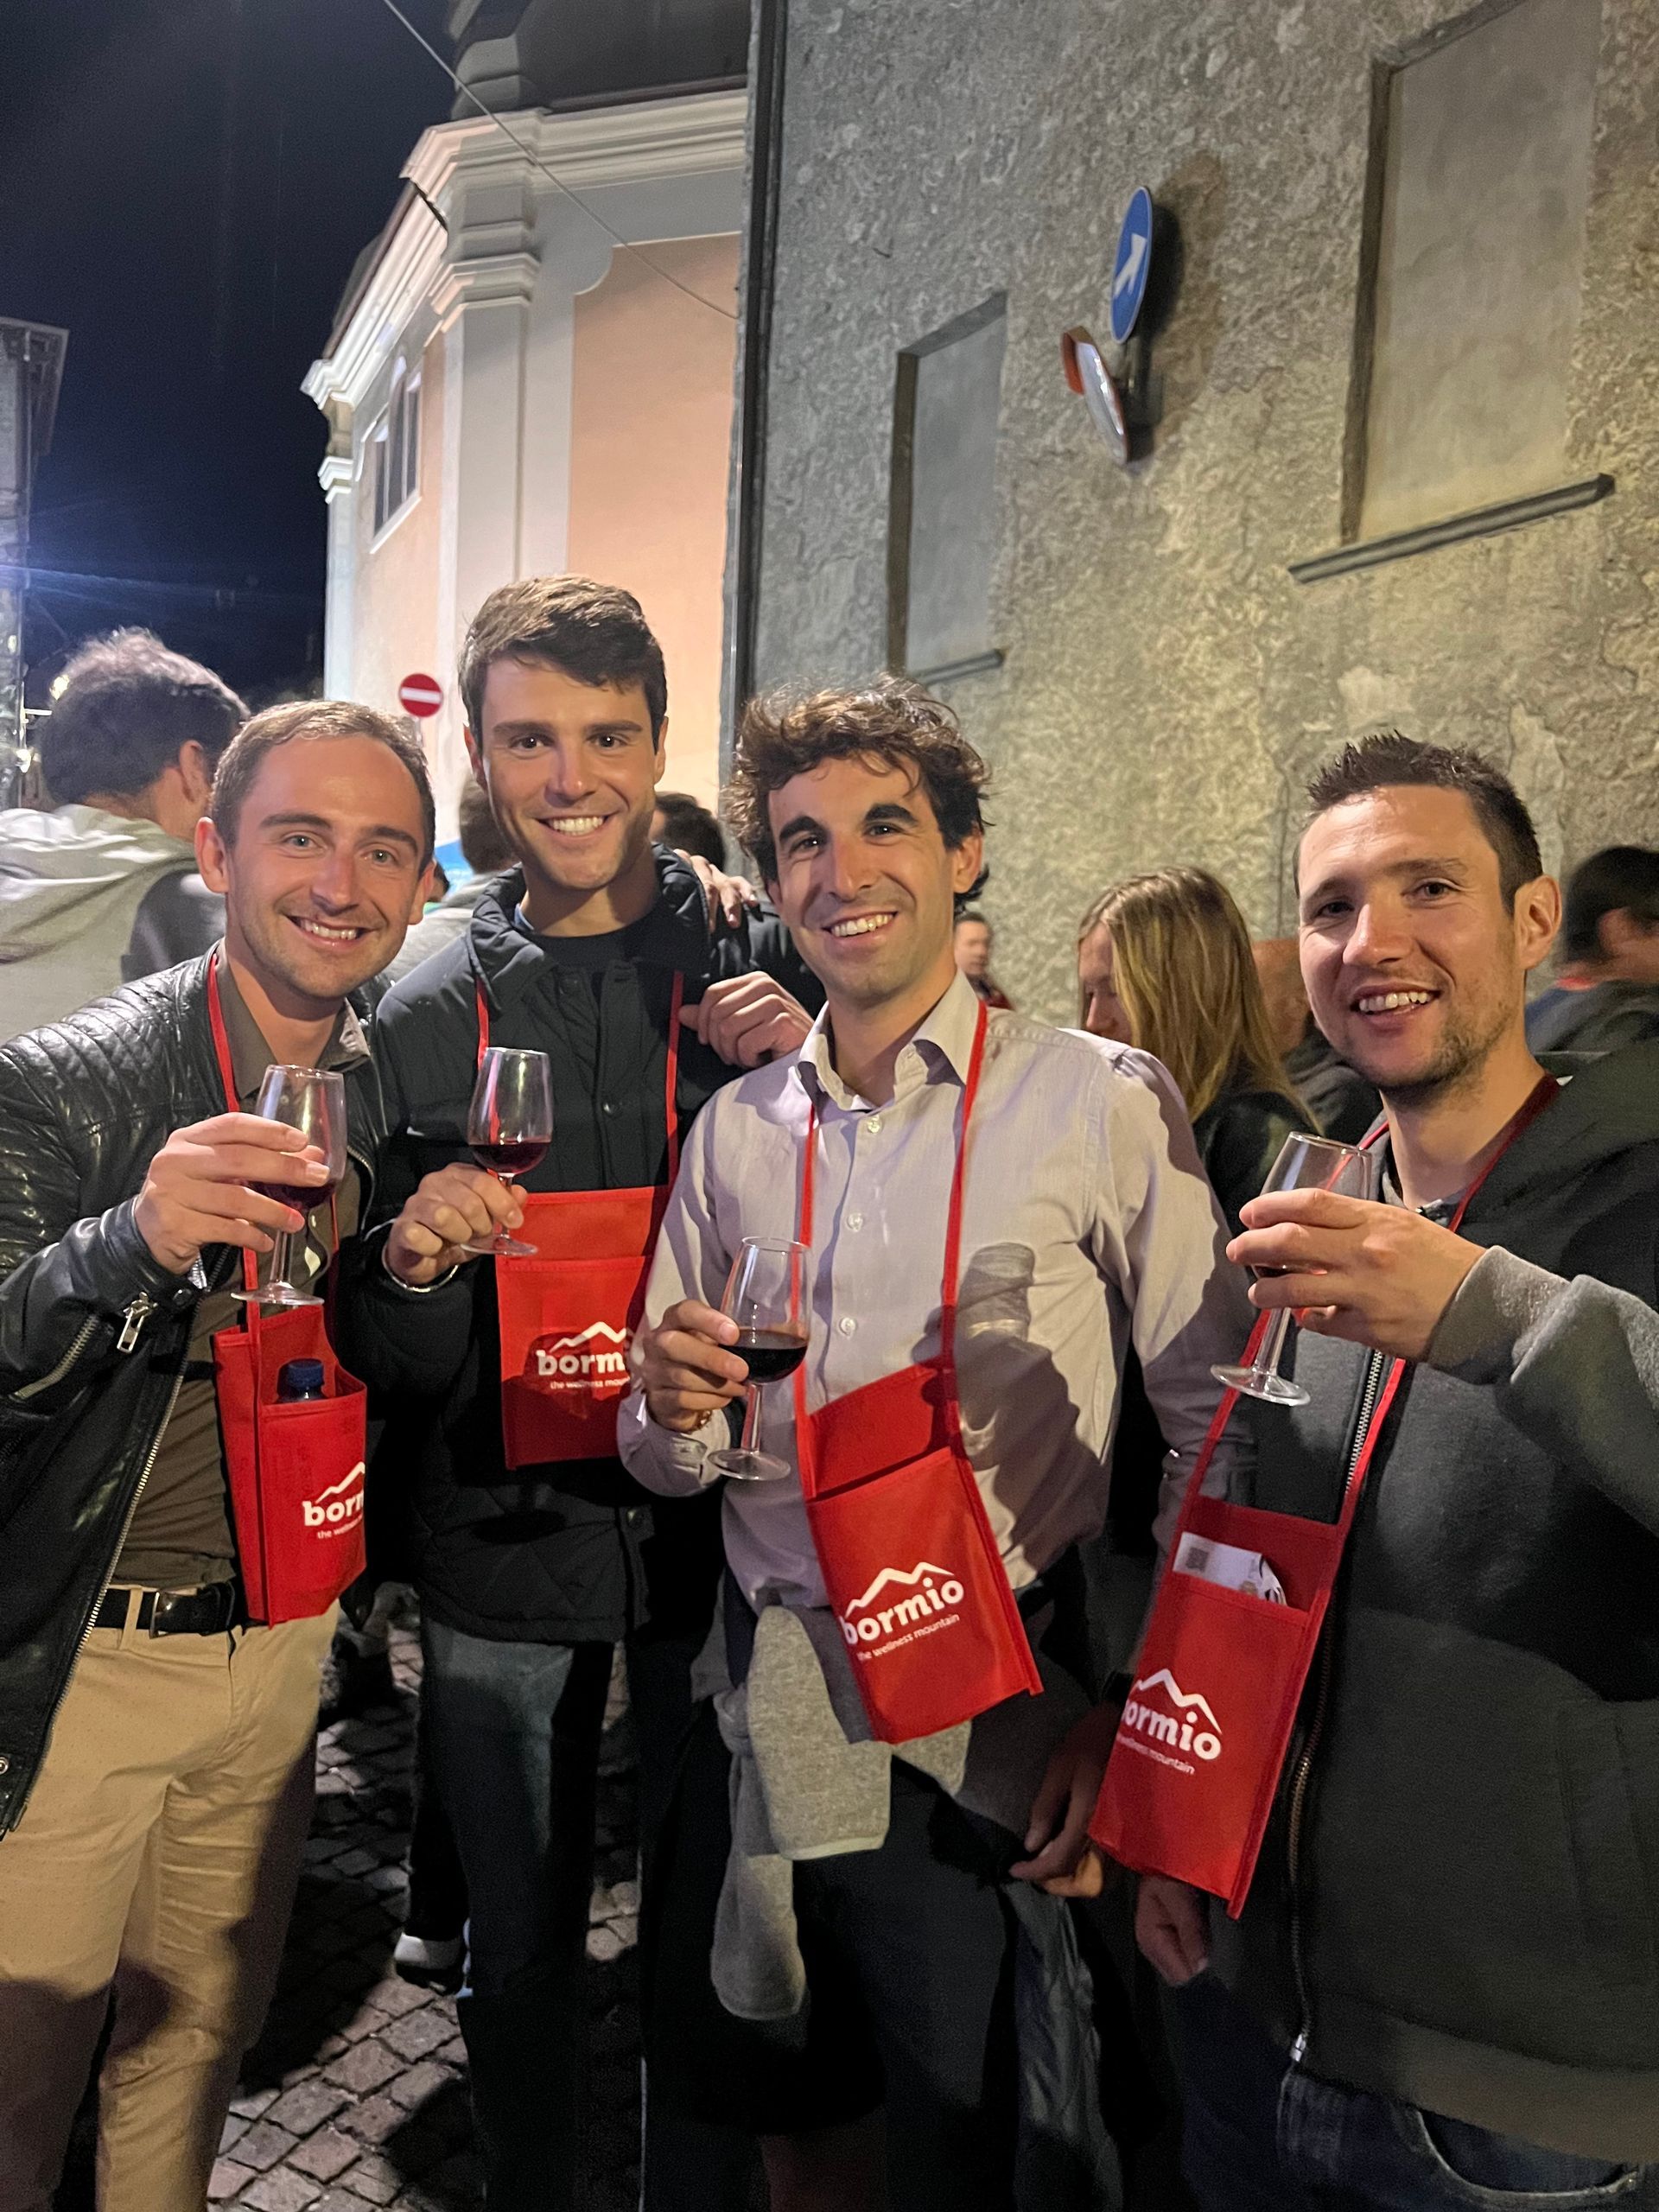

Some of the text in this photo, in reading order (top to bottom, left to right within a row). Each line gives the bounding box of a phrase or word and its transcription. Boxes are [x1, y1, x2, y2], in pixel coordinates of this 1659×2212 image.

[536, 1350, 625, 1376] borm
[839, 1577, 964, 1645] bormio
[872, 1633, 913, 1656] wellness
[913, 1613, 960, 1638] mountain
